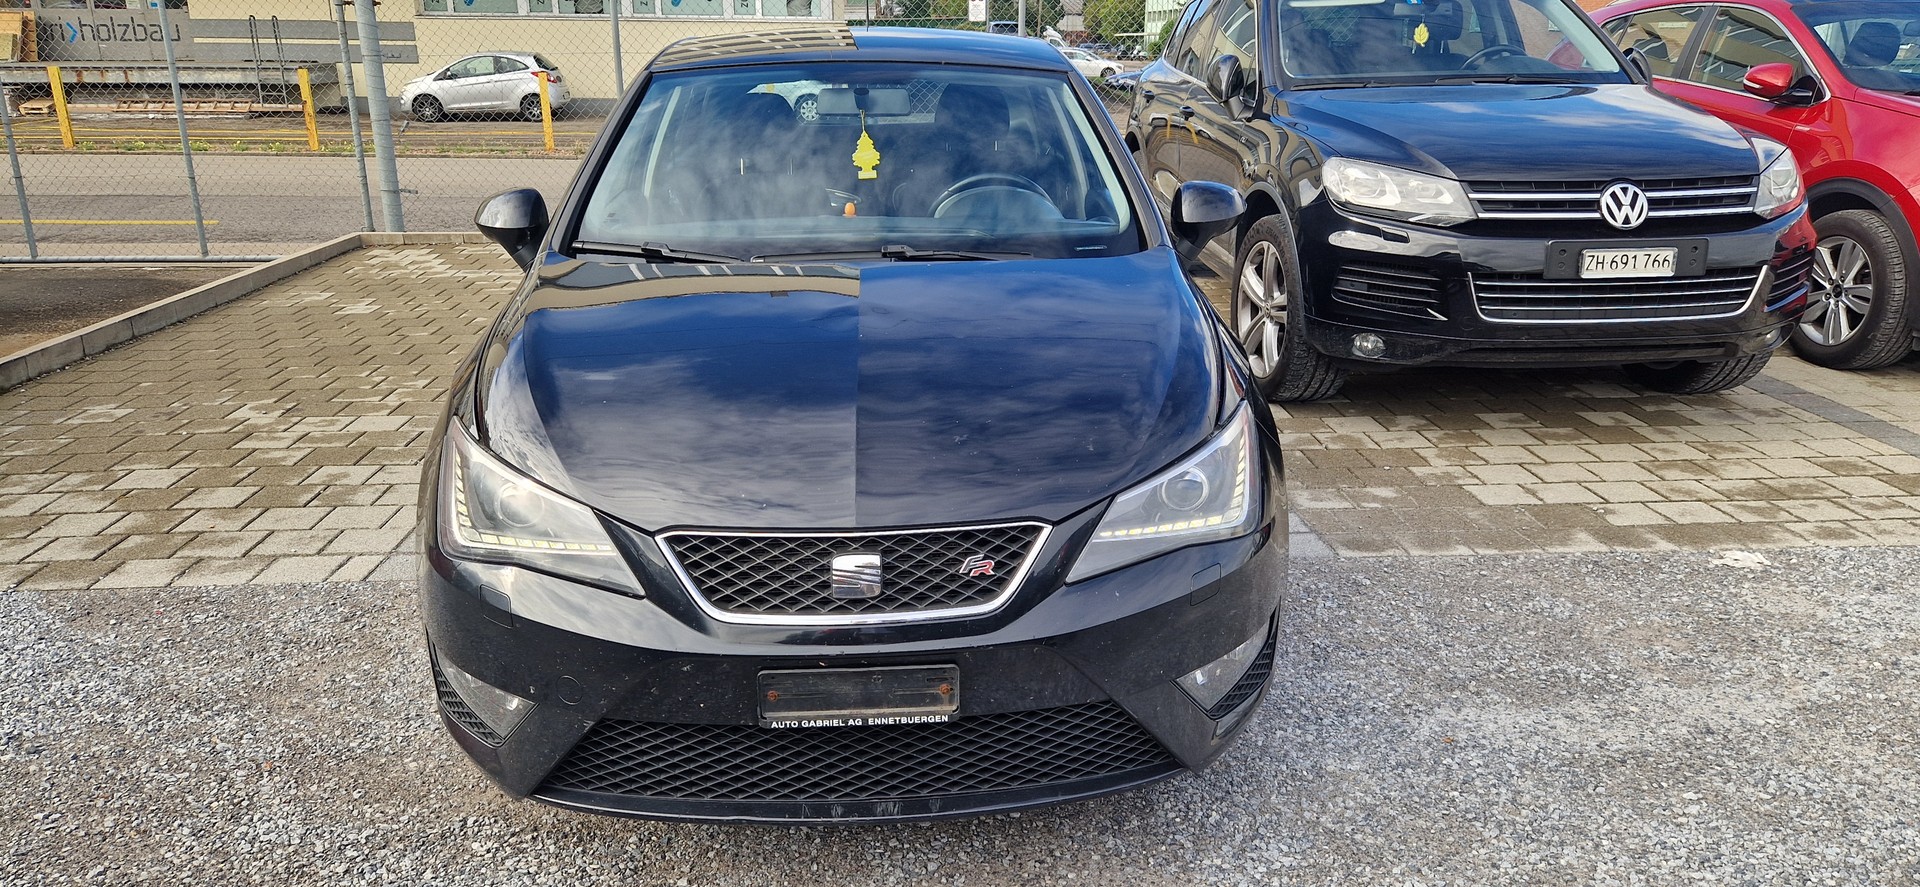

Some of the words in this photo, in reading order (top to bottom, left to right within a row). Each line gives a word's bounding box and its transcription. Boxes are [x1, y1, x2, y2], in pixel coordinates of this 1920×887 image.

[1643, 253, 1671, 269] 766
[959, 554, 995, 577] FR
[771, 720, 799, 729] AUTO
[801, 719, 846, 728] GABRIEL
[847, 718, 863, 726] AG
[868, 714, 949, 725] ENNETBUERGEN
